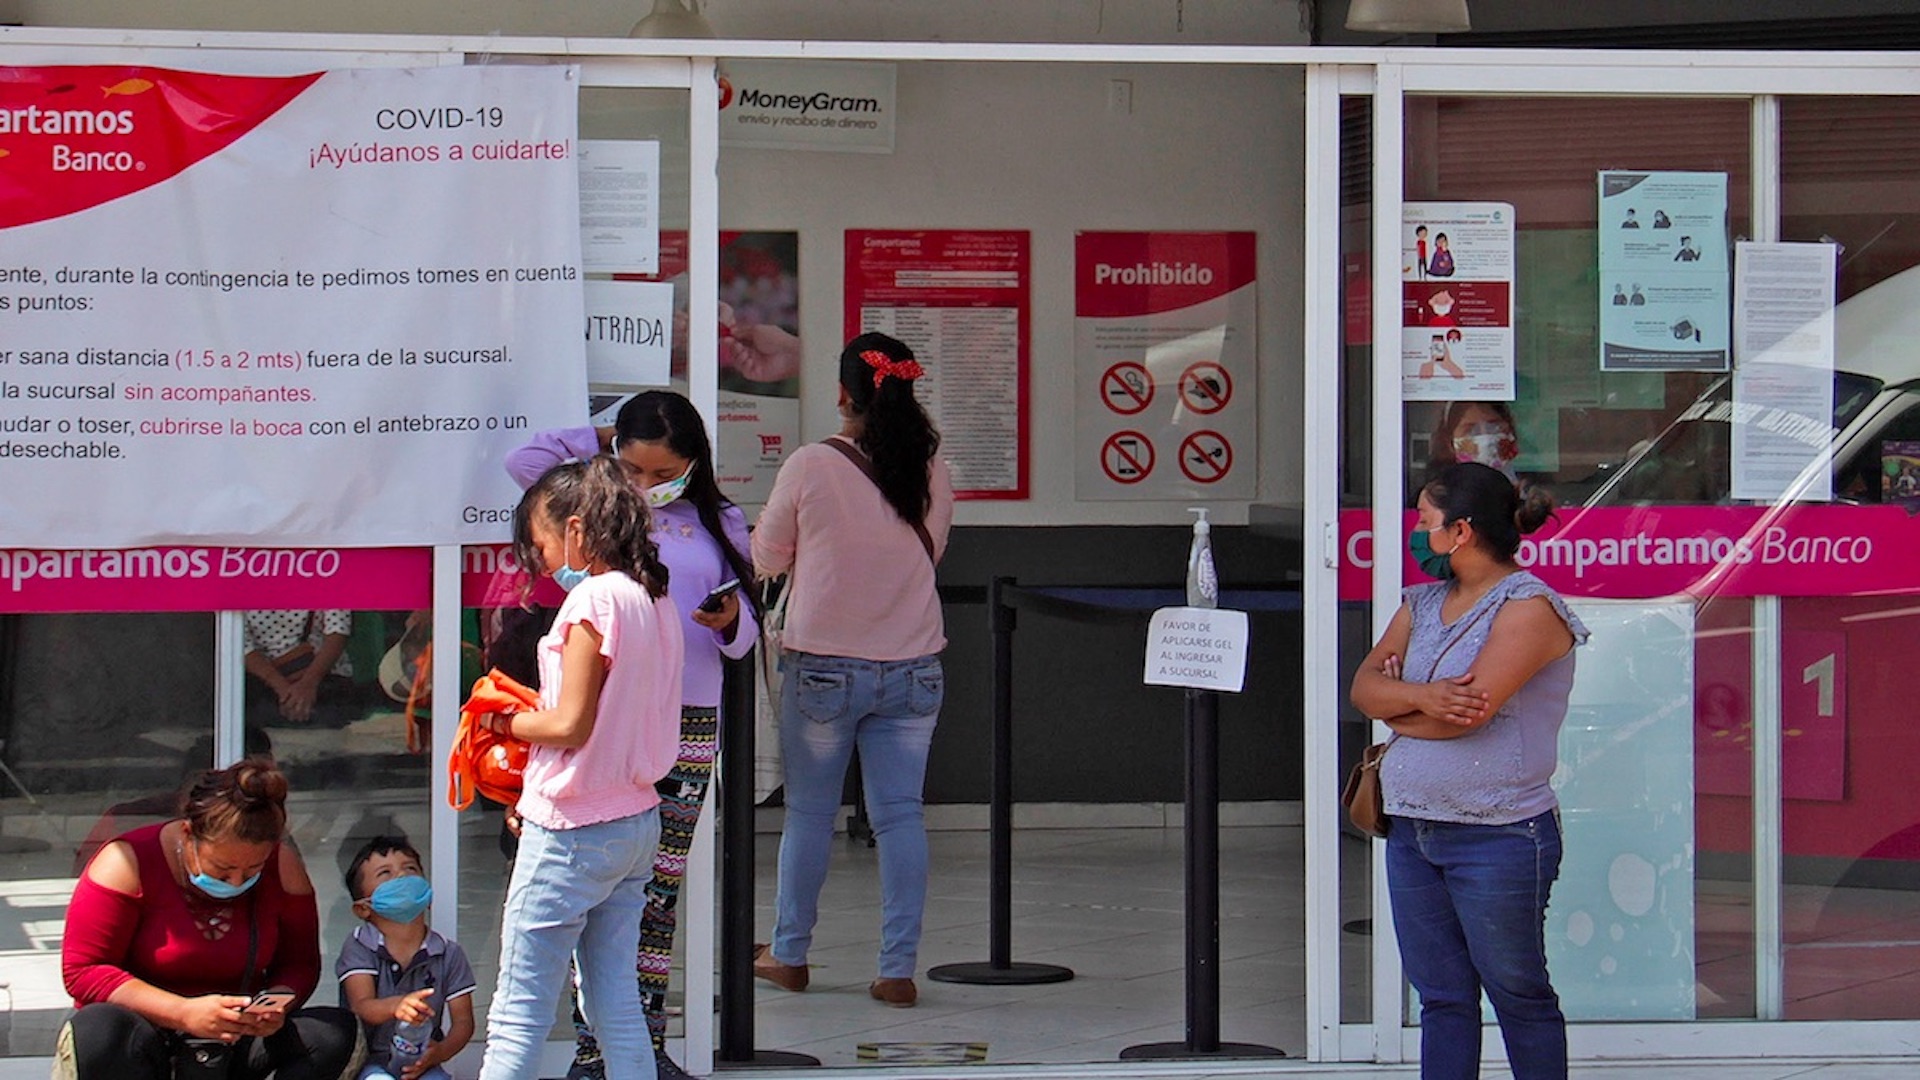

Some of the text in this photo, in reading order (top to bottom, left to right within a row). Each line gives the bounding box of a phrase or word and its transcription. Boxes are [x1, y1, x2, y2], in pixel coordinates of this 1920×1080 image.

[739, 88, 883, 113] MoneyGram.
[377, 107, 503, 130] COVID-19
[838, 117, 877, 129] dinero
[53, 145, 133, 171] Banco
[310, 142, 440, 169] ¡Ayúdanos
[448, 147, 463, 160] a
[472, 139, 570, 161] cuidarte!
[55, 266, 134, 284] durante
[142, 268, 158, 285] la
[165, 271, 290, 292] contingencia
[296, 271, 314, 287] te
[322, 267, 411, 291] pedimos
[417, 265, 479, 284] tomes
[486, 266, 509, 282] en
[515, 264, 577, 281] cuenta
[1095, 262, 1213, 285] Prohibido
[18, 294, 94, 314] puntos:
[19, 351, 69, 366] sana
[76, 347, 169, 367] distancia
[175, 349, 215, 370] (1.5
[221, 355, 232, 367] a
[237, 351, 250, 369] 2
[257, 350, 303, 372] mts)
[307, 351, 360, 368] fuera
[367, 348, 393, 366] de
[400, 348, 417, 365] la
[423, 345, 513, 364] sucursal.
[3, 382, 316, 404] la sucursal sin acompañantes.
[0, 412, 528, 437] udar o toser, cubrirse la boca con el antebrazo o un
[0, 440, 126, 460] desechable.
[1761, 527, 1872, 564] Banco
[219, 547, 340, 578] Banco
[1162, 621, 1211, 632] FAVOR DE
[1161, 636, 1232, 650] APLICARSE GEL
[1160, 652, 1222, 663] AL INGRESAR
[1159, 667, 1218, 679] A SUCURSAL
[1803, 653, 1835, 716] 1
